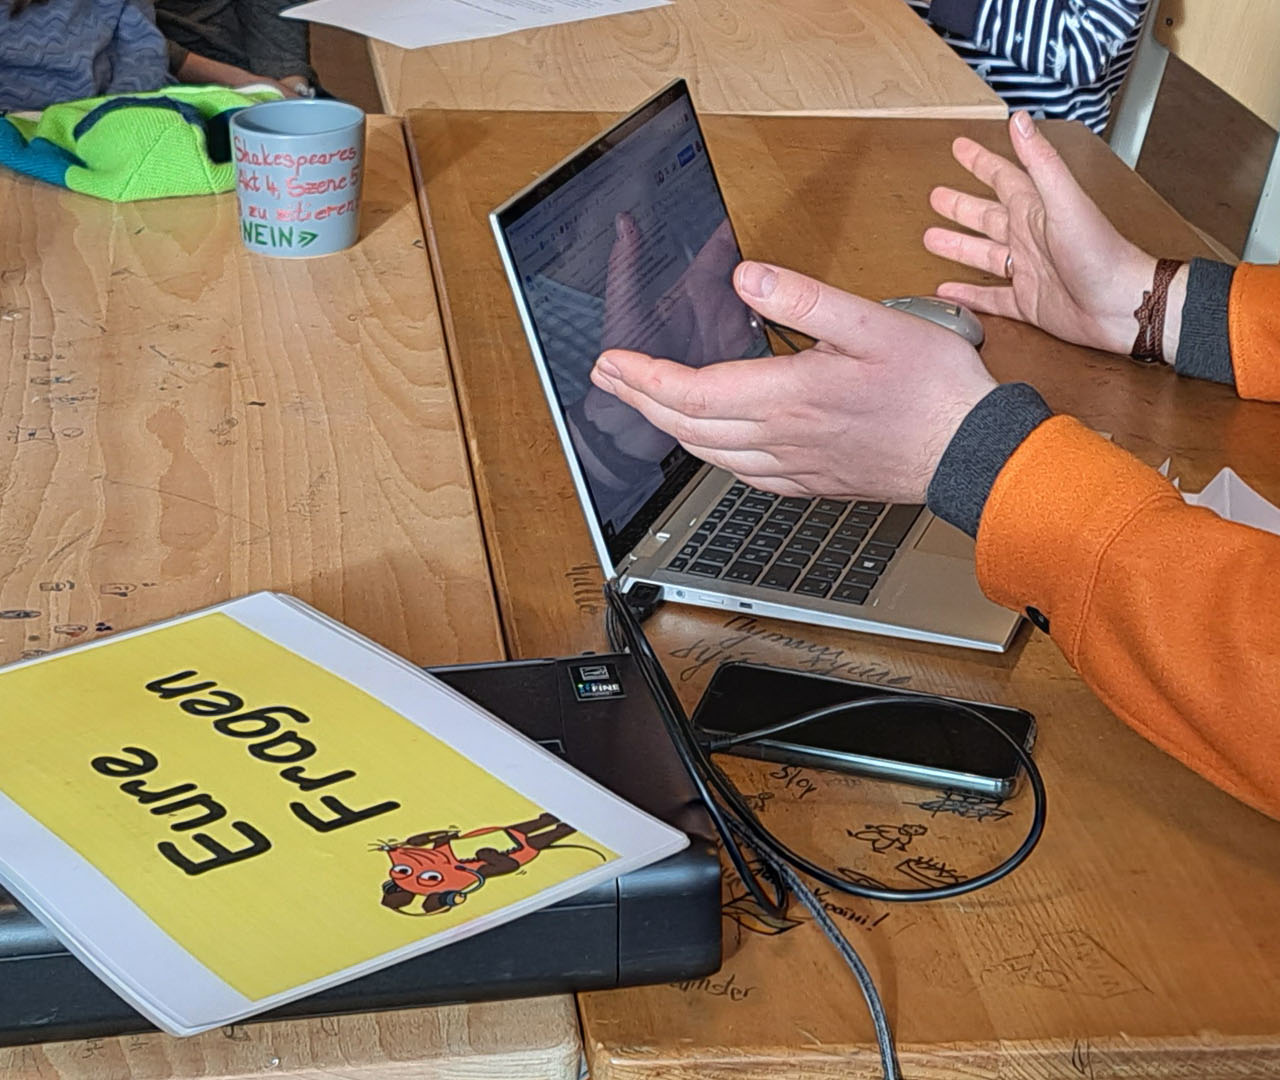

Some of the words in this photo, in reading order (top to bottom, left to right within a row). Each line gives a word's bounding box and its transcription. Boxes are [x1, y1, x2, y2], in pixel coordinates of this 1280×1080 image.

[233, 135, 358, 177] Shakespeares
[286, 174, 348, 198] Szene
[242, 219, 294, 249] NEIN
[144, 668, 401, 834] Fragen
[90, 744, 273, 878] Eure
